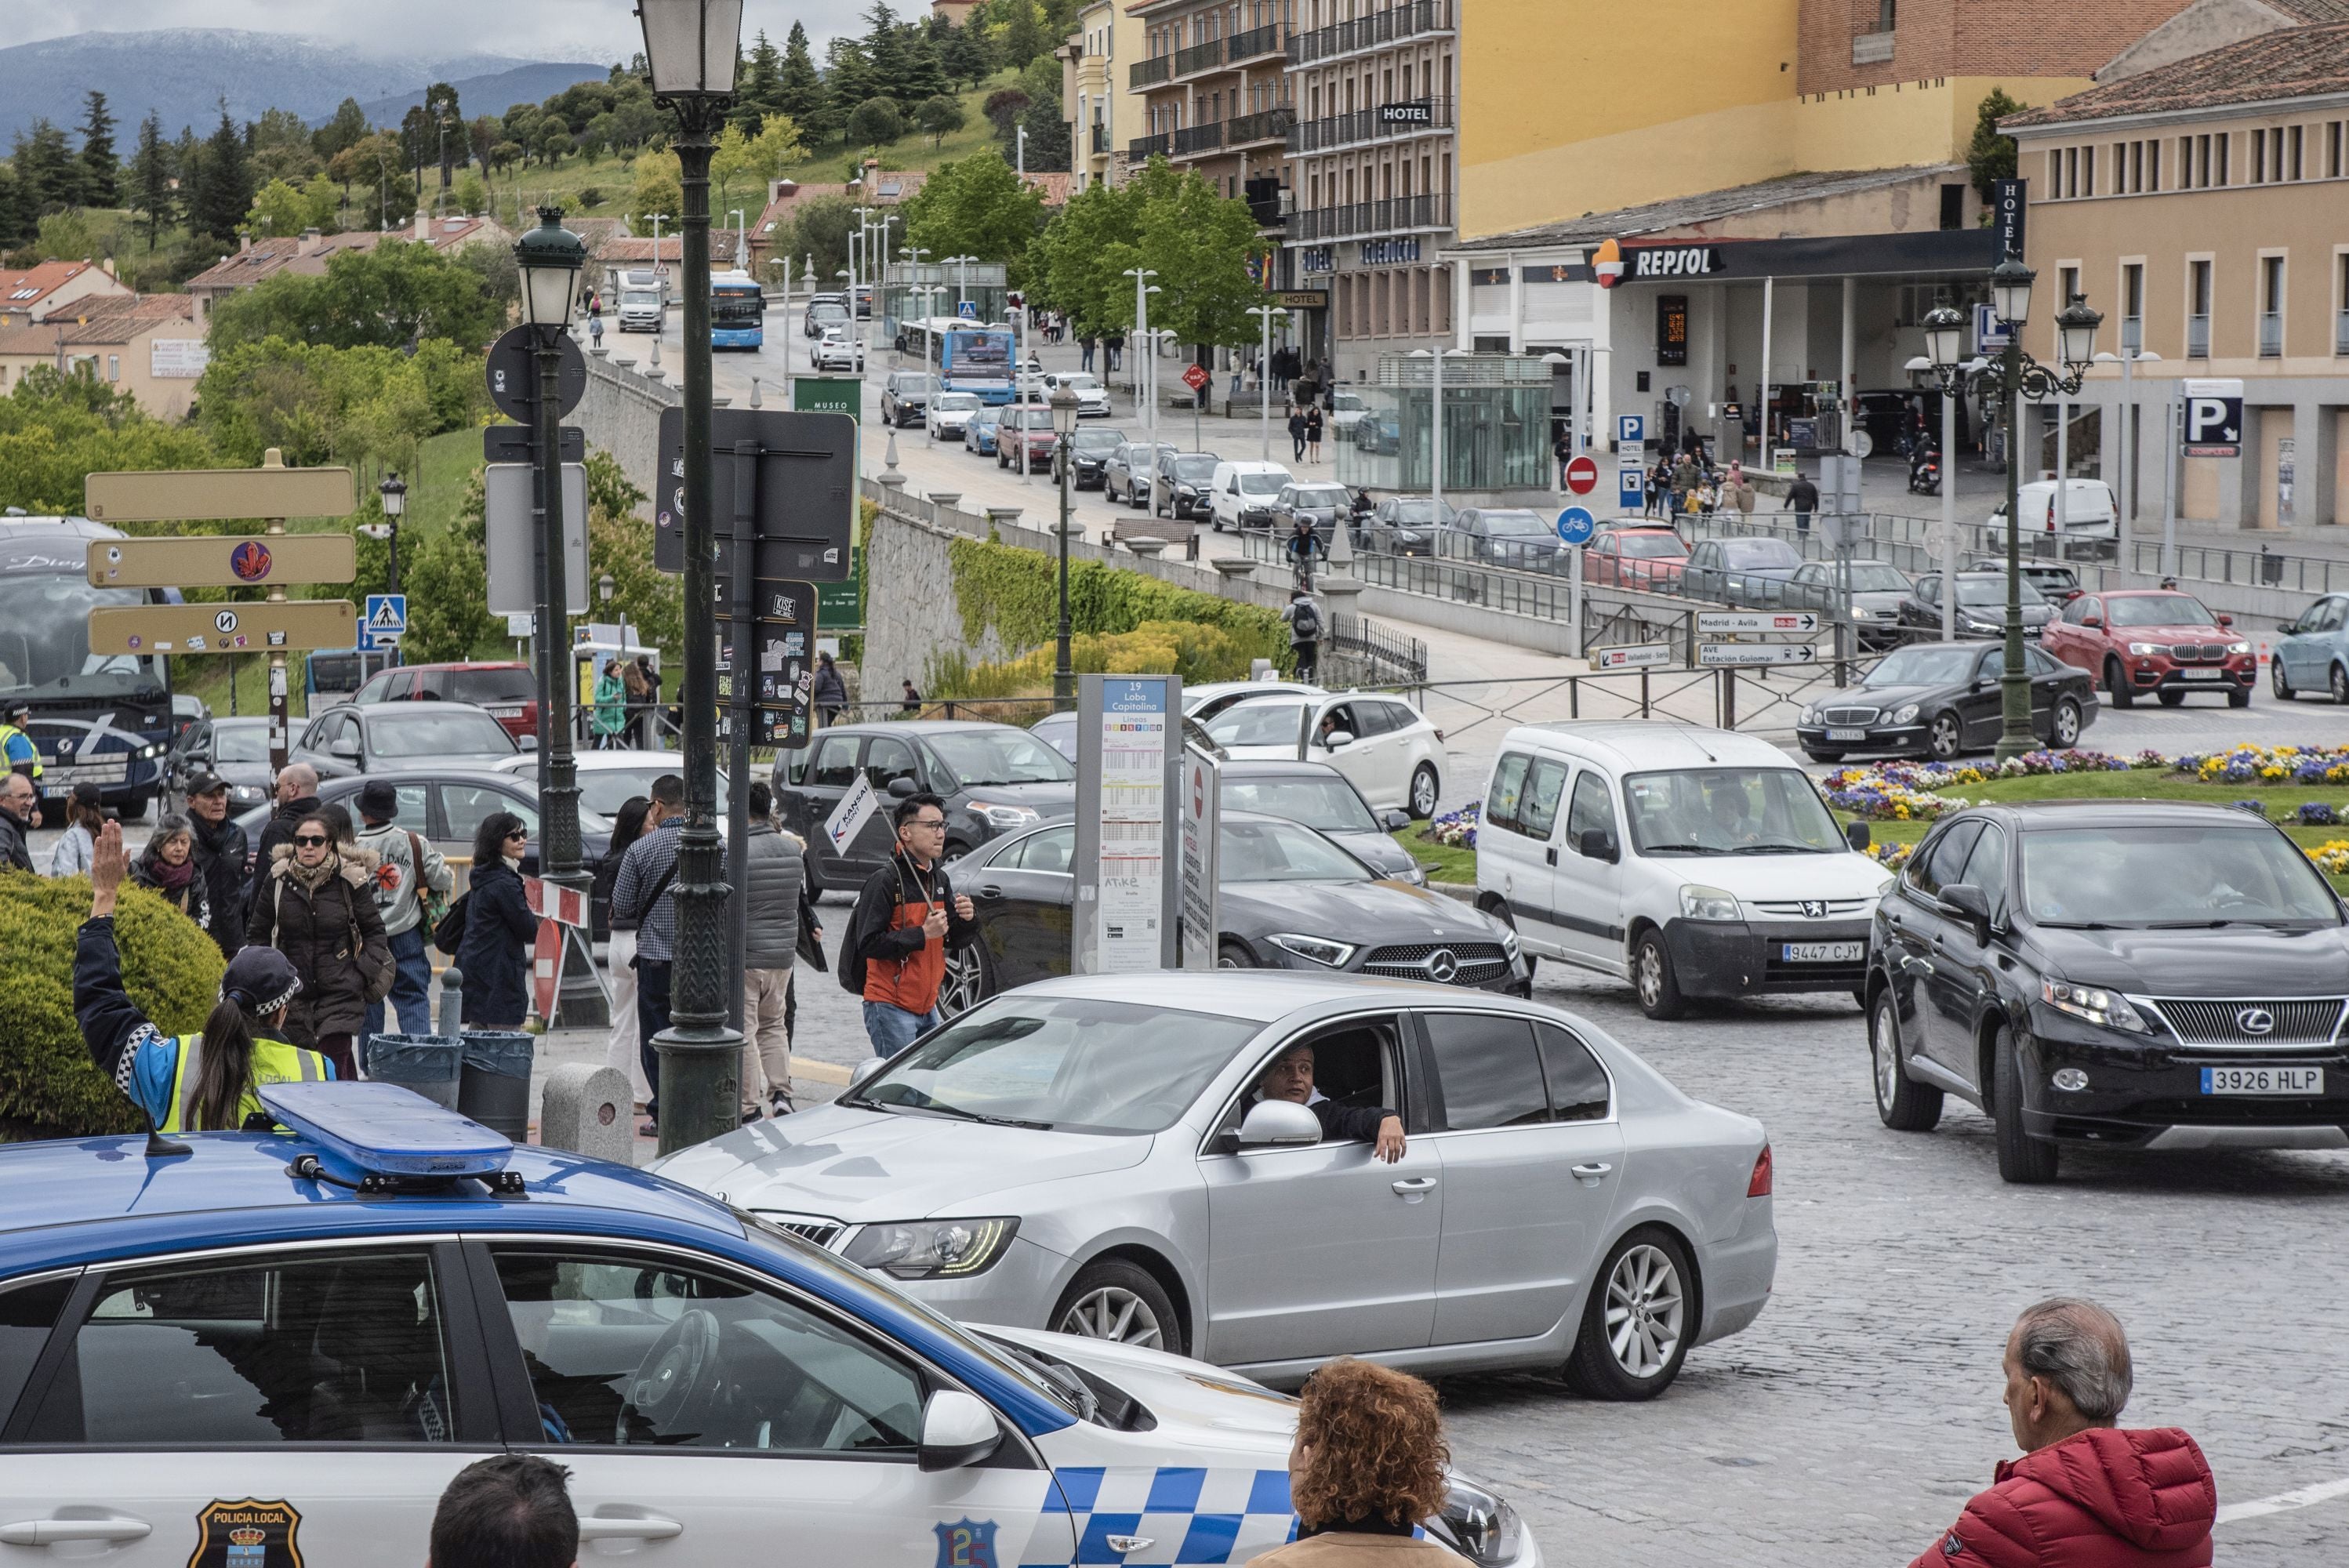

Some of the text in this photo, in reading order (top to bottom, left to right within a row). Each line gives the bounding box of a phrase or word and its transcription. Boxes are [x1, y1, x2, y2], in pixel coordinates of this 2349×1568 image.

[1384, 108, 1429, 119] HOTEL
[2004, 185, 2017, 252] HOTEL
[1636, 248, 1711, 275] REPSOL
[1285, 295, 1318, 303] HOTEL
[1623, 418, 1639, 438] P
[2190, 398, 2227, 441] P
[776, 597, 793, 612] KISE
[1628, 652, 1651, 661] Valladolid
[1130, 682, 1142, 691] 19
[1112, 702, 1156, 712] Capitolina
[842, 785, 868, 822] KANSAI
[845, 806, 861, 827] PAINT
[1185, 835, 1196, 852] HOTELES
[1185, 851, 1200, 873] RESIDENTES
[1185, 868, 1199, 889] URGENCIAS
[1185, 884, 1197, 905] SERVICIOS
[1200, 915, 1208, 934] RUEDAS
[1792, 945, 1859, 960] 9447 CJY
[259, 1073, 292, 1083] LOCAL
[2216, 1071, 2317, 1090] 3926 HLP
[214, 1513, 285, 1523] POLICIA LOCAL
